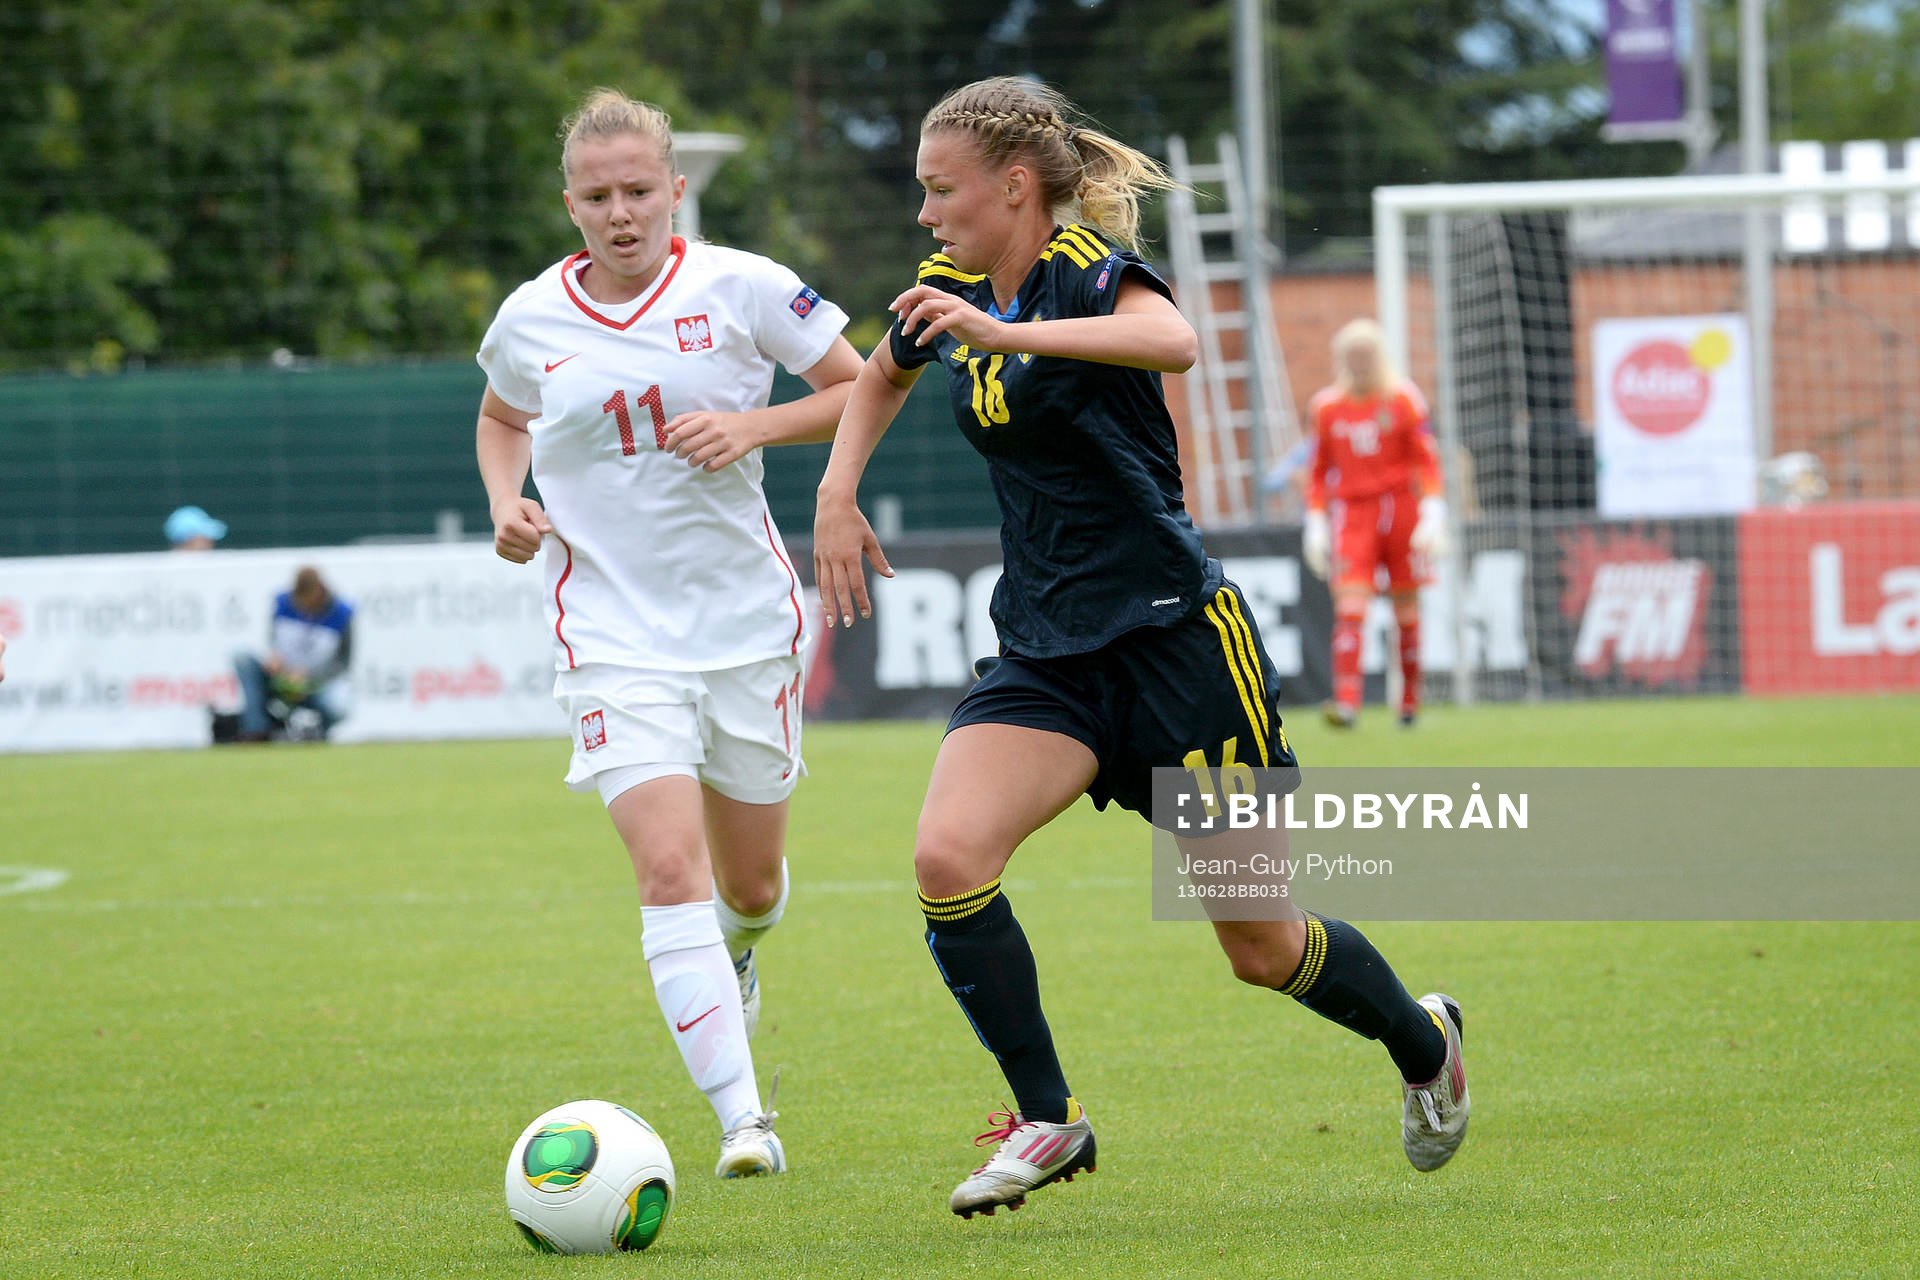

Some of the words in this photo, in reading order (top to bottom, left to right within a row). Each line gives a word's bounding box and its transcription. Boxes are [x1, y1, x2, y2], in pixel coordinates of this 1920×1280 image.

[805, 288, 819, 301] R
[603, 384, 668, 457] 11
[967, 354, 1011, 428] 16
[1182, 736, 1257, 818] 16
